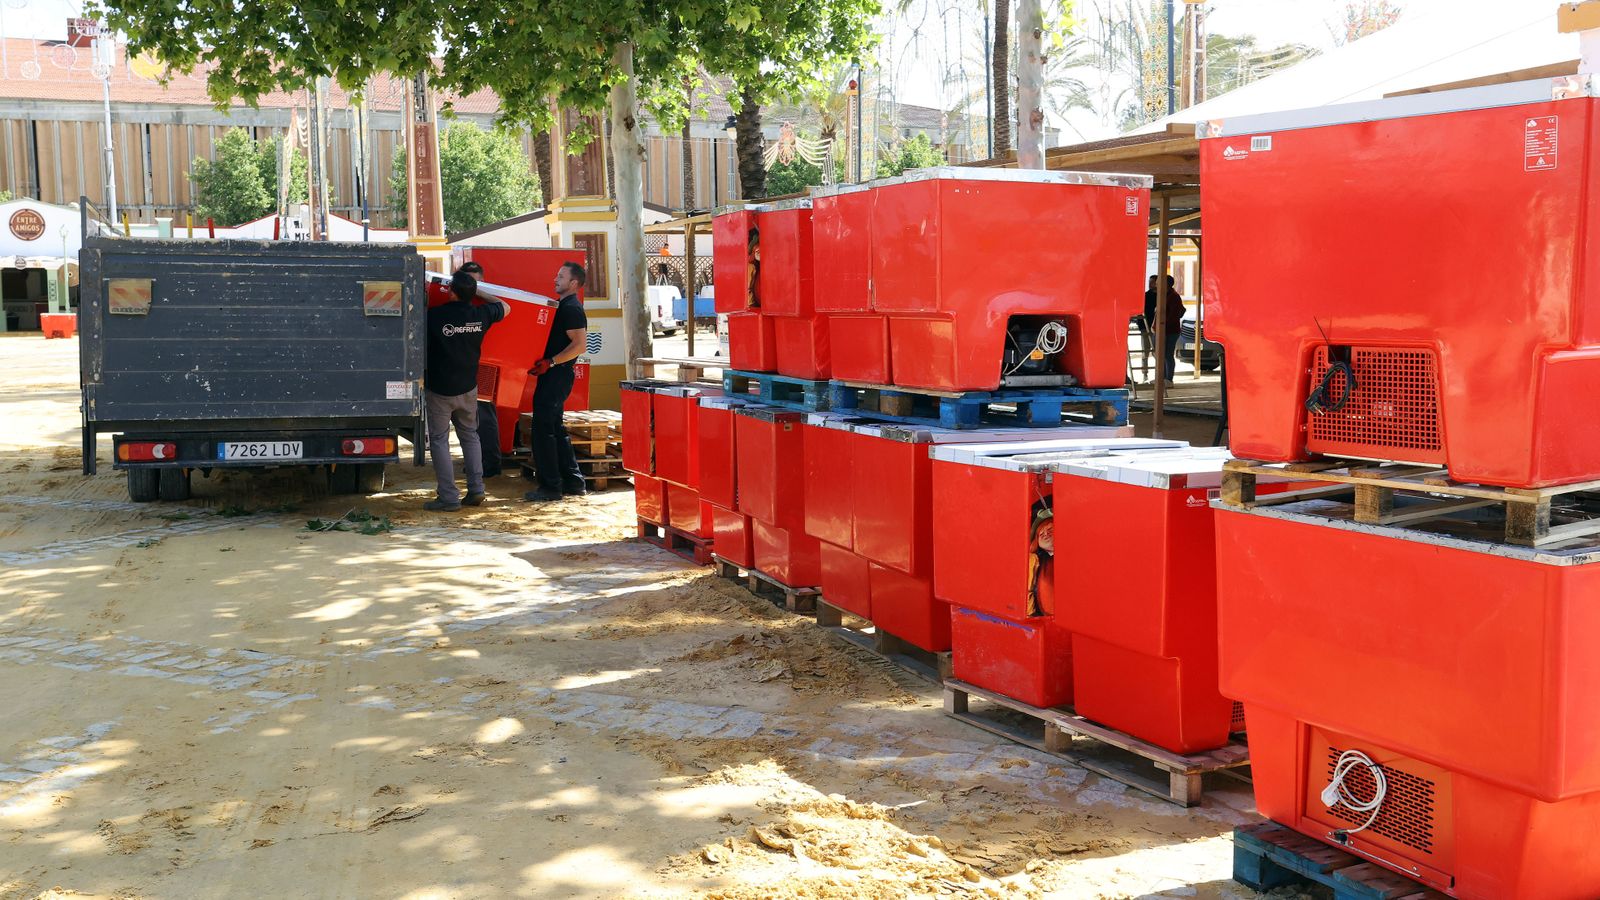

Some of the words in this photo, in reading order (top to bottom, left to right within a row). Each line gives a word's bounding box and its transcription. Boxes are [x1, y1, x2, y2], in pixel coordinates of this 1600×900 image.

[16, 216, 38, 225] ENTRE
[15, 224, 40, 232] AMIGOS
[230, 444, 268, 457] 7262
[273, 443, 300, 457] LDV
